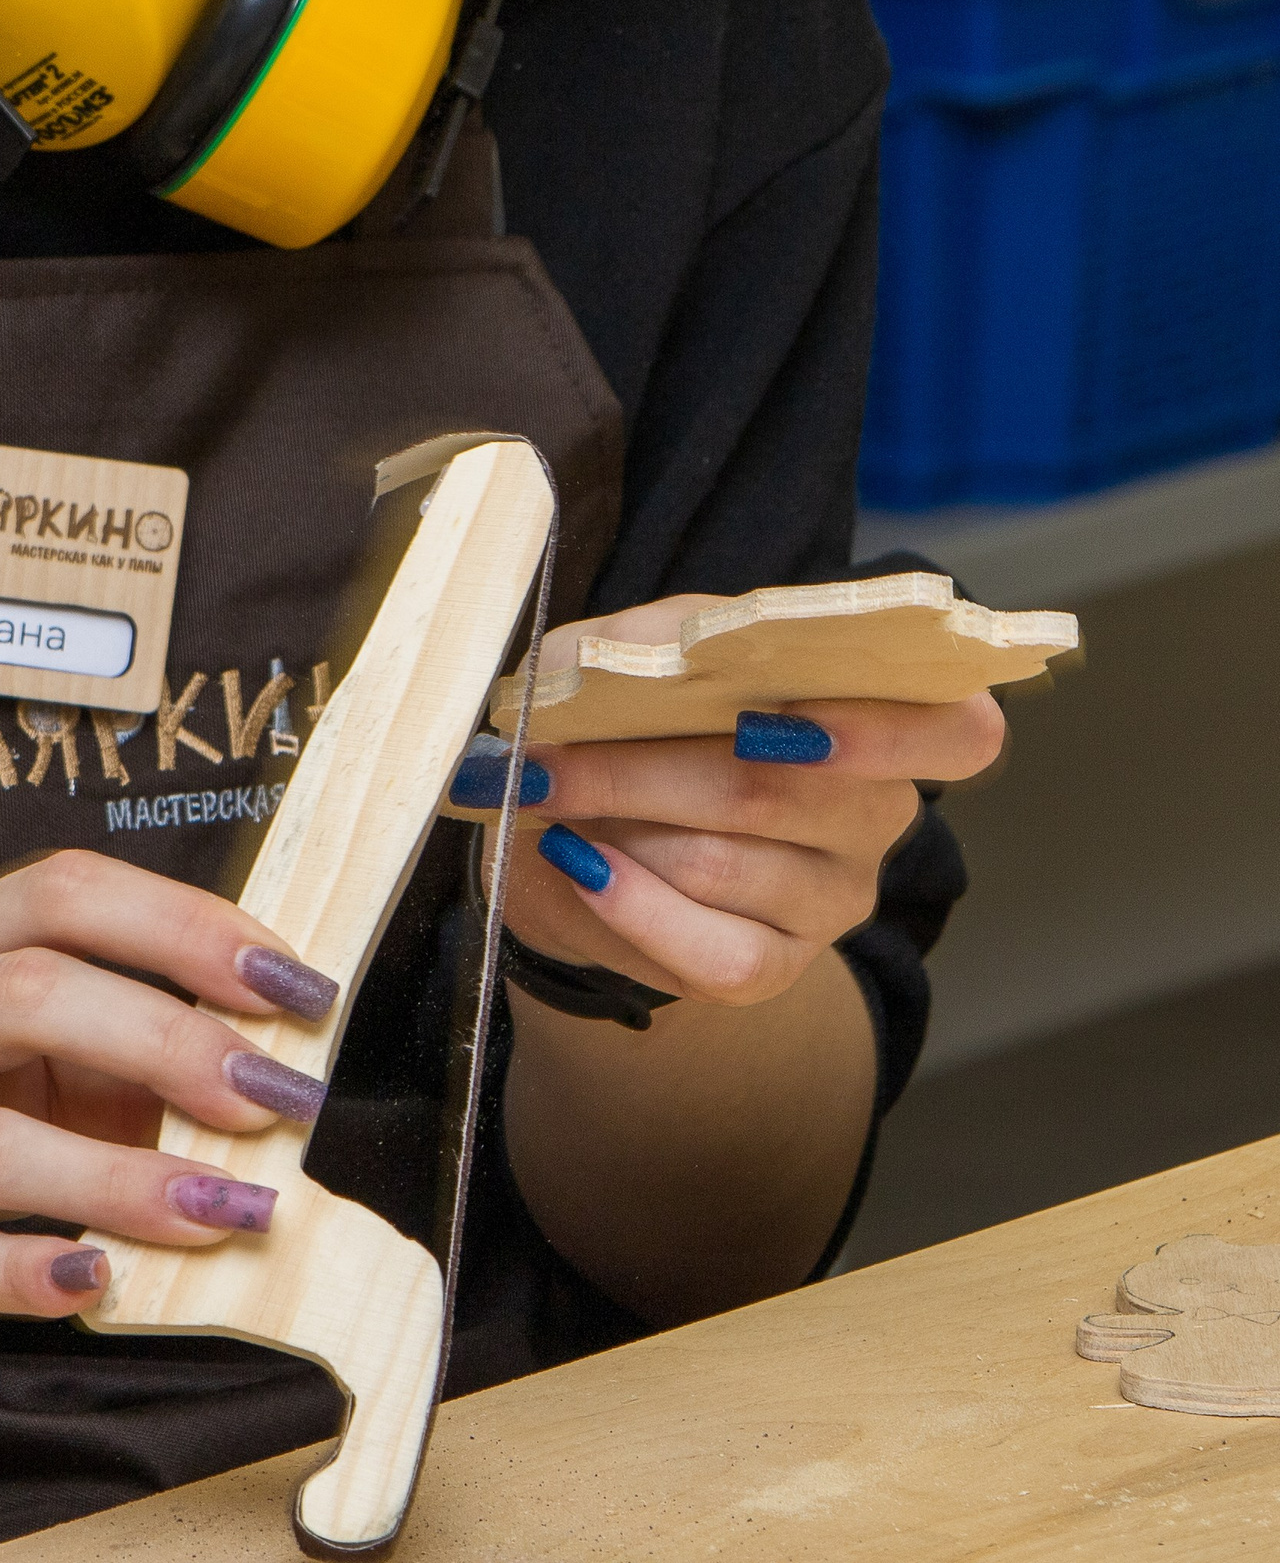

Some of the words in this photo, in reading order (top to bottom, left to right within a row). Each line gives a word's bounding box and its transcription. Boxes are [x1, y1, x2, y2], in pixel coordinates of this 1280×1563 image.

[11, 543, 88, 565] МАСТЕРСКАЯ
[91, 553, 115, 569] КАК
[117, 557, 126, 571] У
[128, 557, 164, 575] ПАПЫ
